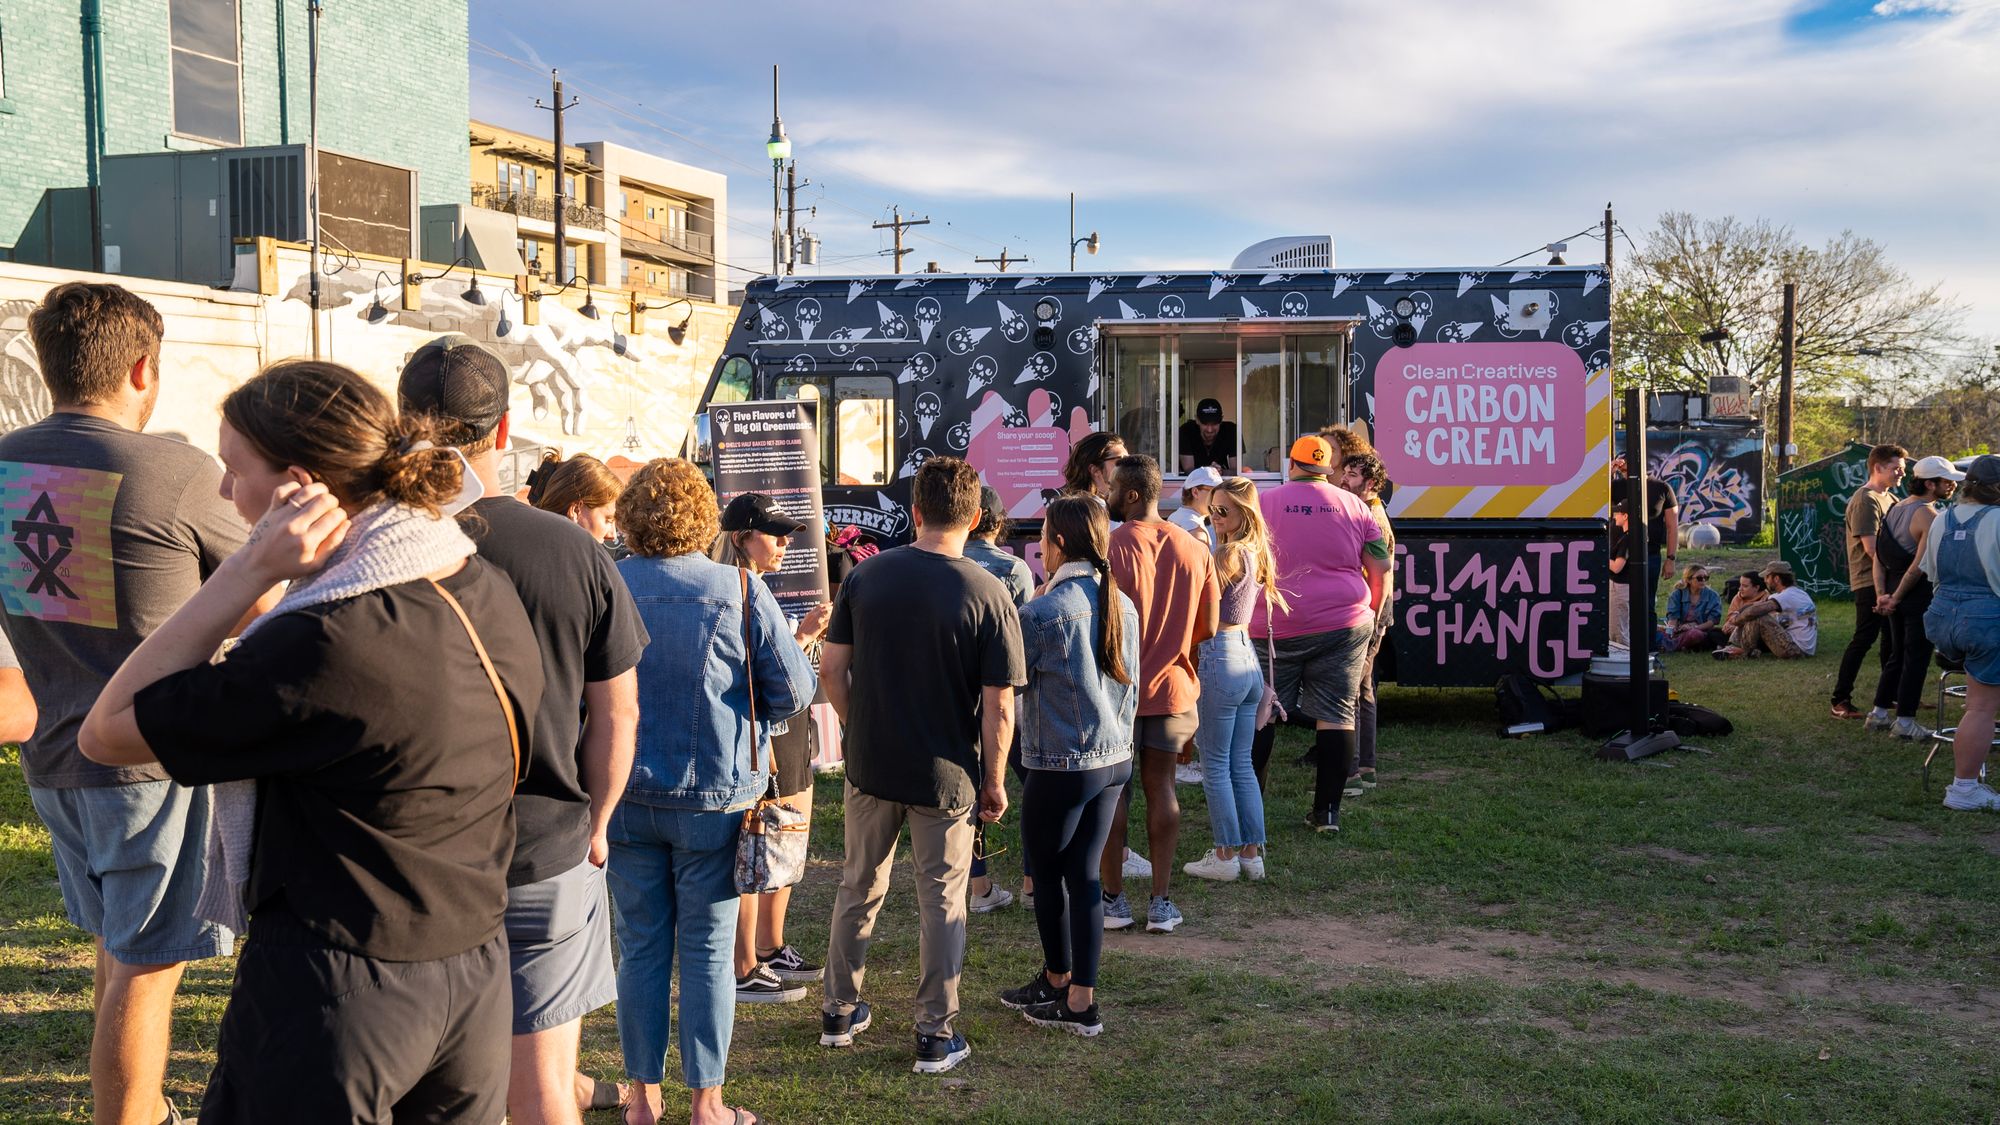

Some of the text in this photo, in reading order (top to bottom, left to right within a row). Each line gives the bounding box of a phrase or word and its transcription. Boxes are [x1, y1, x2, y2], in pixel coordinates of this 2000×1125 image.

[1403, 364, 1557, 380] Clean Creatives
[1405, 383, 1555, 424] CARBON
[733, 409, 796, 421] Five Flavors of
[734, 423, 749, 434] Big
[750, 422, 762, 432] Oil
[997, 430, 1057, 441] Share your scoop!
[1320, 505, 1341, 513] hulu
[21, 561, 32, 573] 20
[60, 566, 70, 578] 20
[1406, 598, 1594, 679] CHANGE
